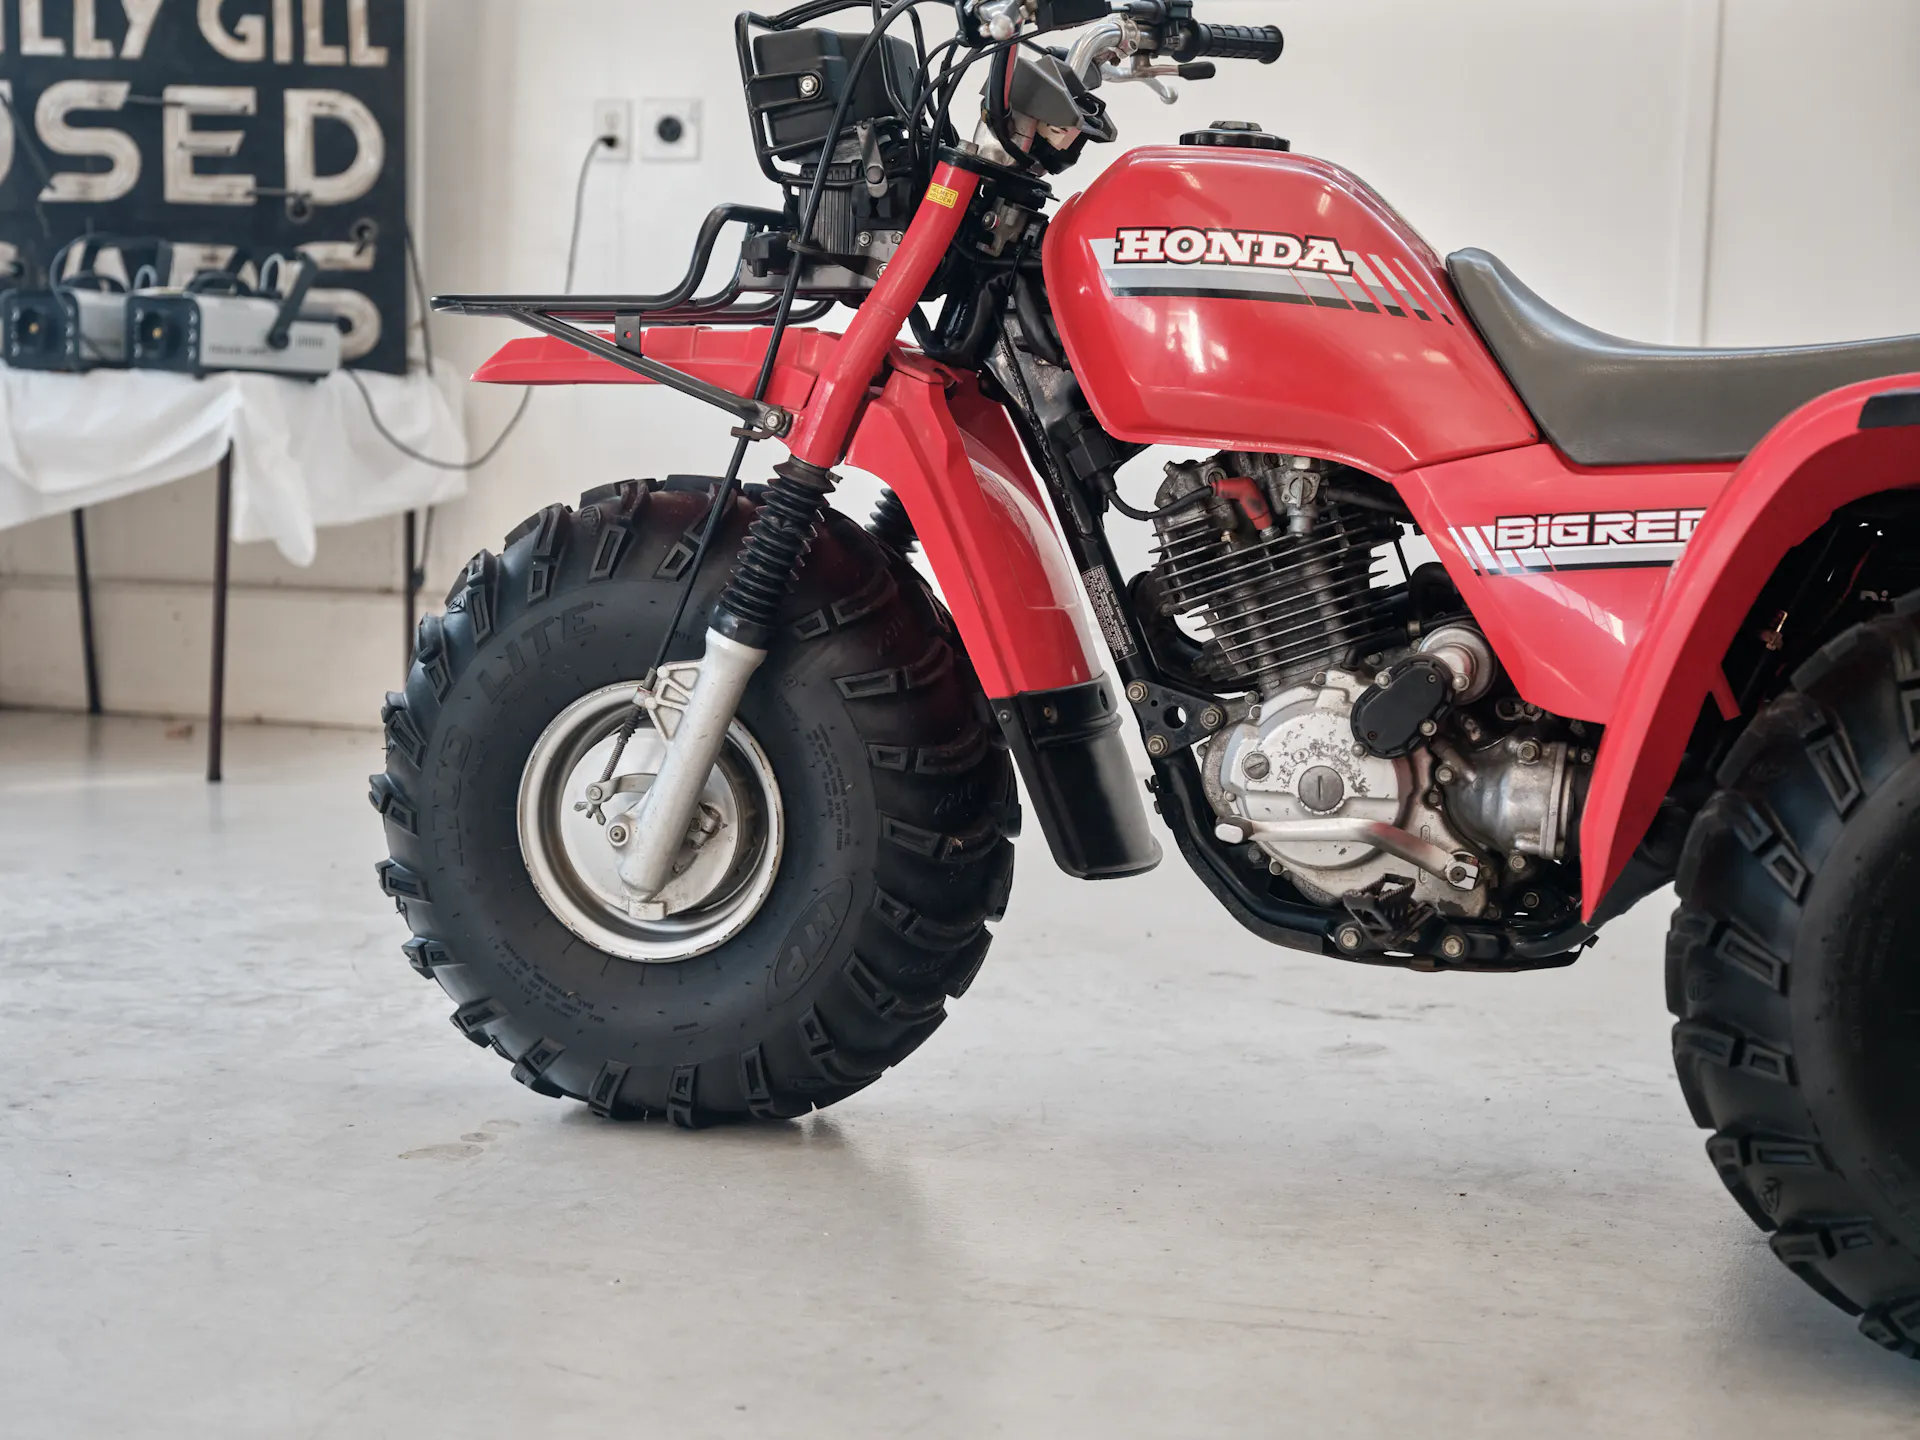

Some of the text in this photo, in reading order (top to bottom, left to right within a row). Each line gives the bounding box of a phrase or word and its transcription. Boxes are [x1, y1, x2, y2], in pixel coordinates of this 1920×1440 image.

[0, 0, 163, 60] LLY
[0, 79, 386, 206] SED
[1115, 228, 1352, 275] HONDA
[477, 600, 597, 704] LITE
